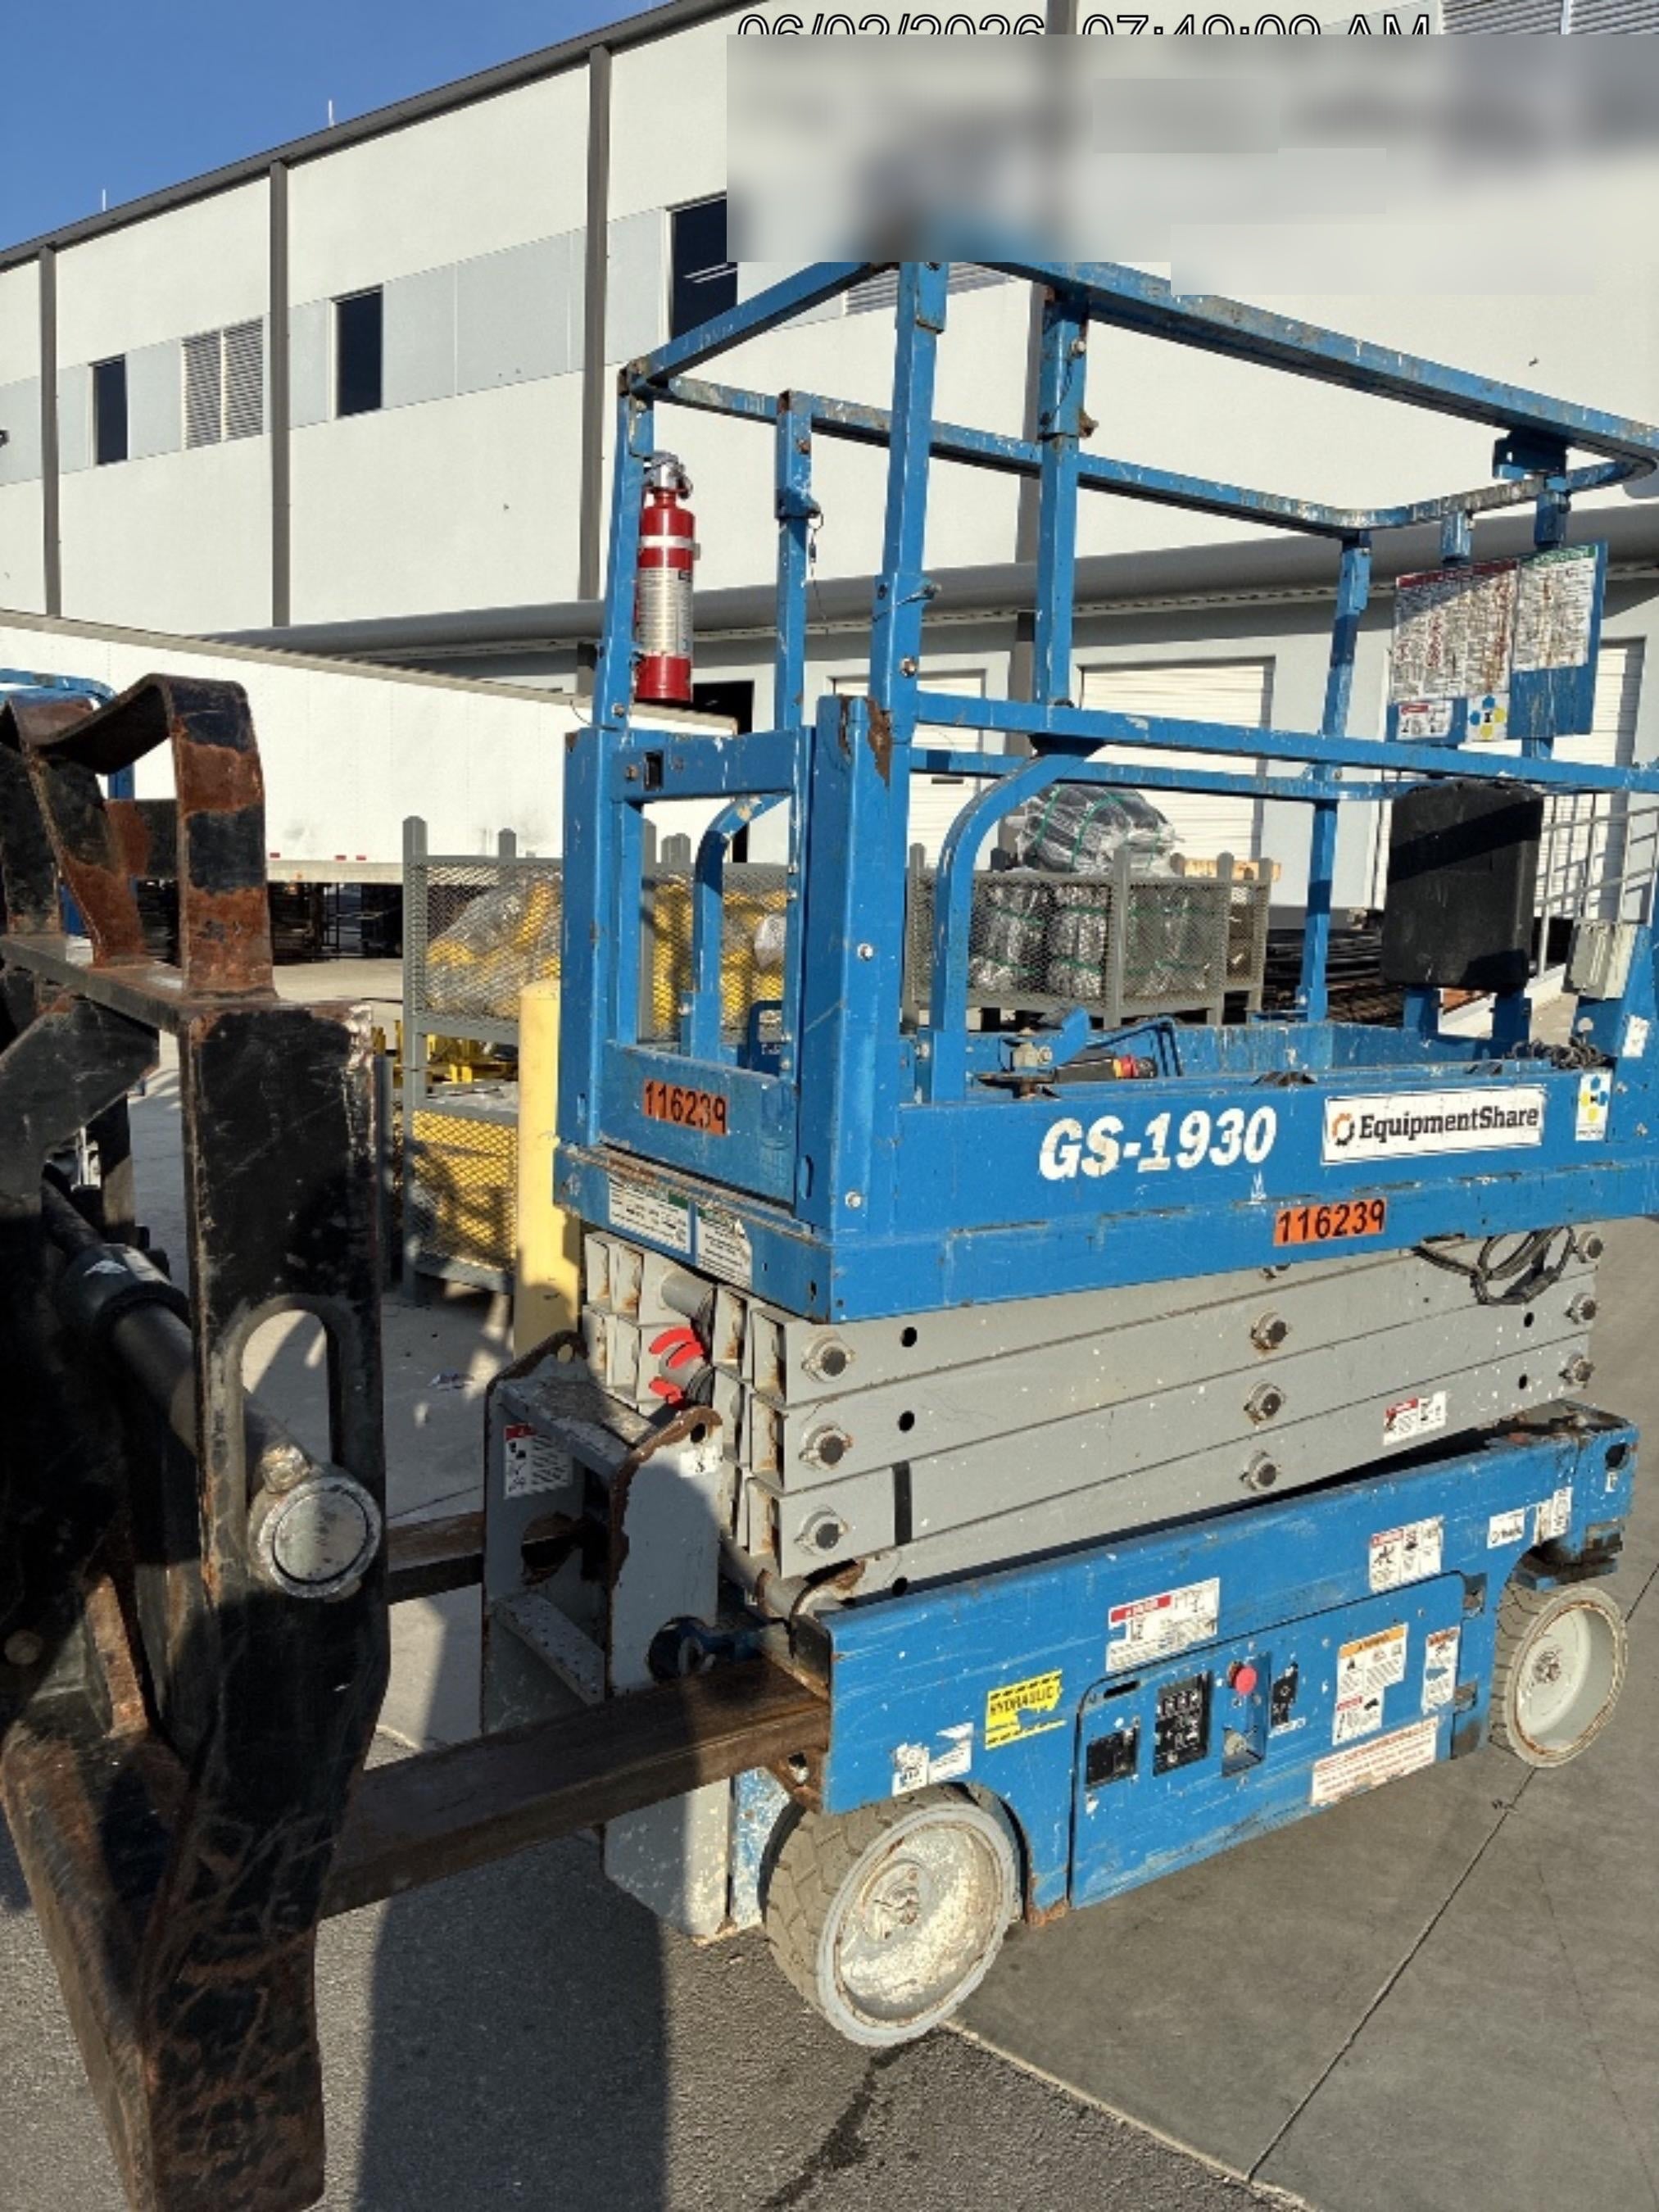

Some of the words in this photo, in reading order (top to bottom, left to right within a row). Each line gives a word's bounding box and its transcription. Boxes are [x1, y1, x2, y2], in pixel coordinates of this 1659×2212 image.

[644, 1080, 727, 1135] 116239
[1358, 1105, 1539, 1140] EquipmentShare
[1038, 1106, 1277, 1181] GS-1930
[1278, 1199, 1385, 1243] 116239
